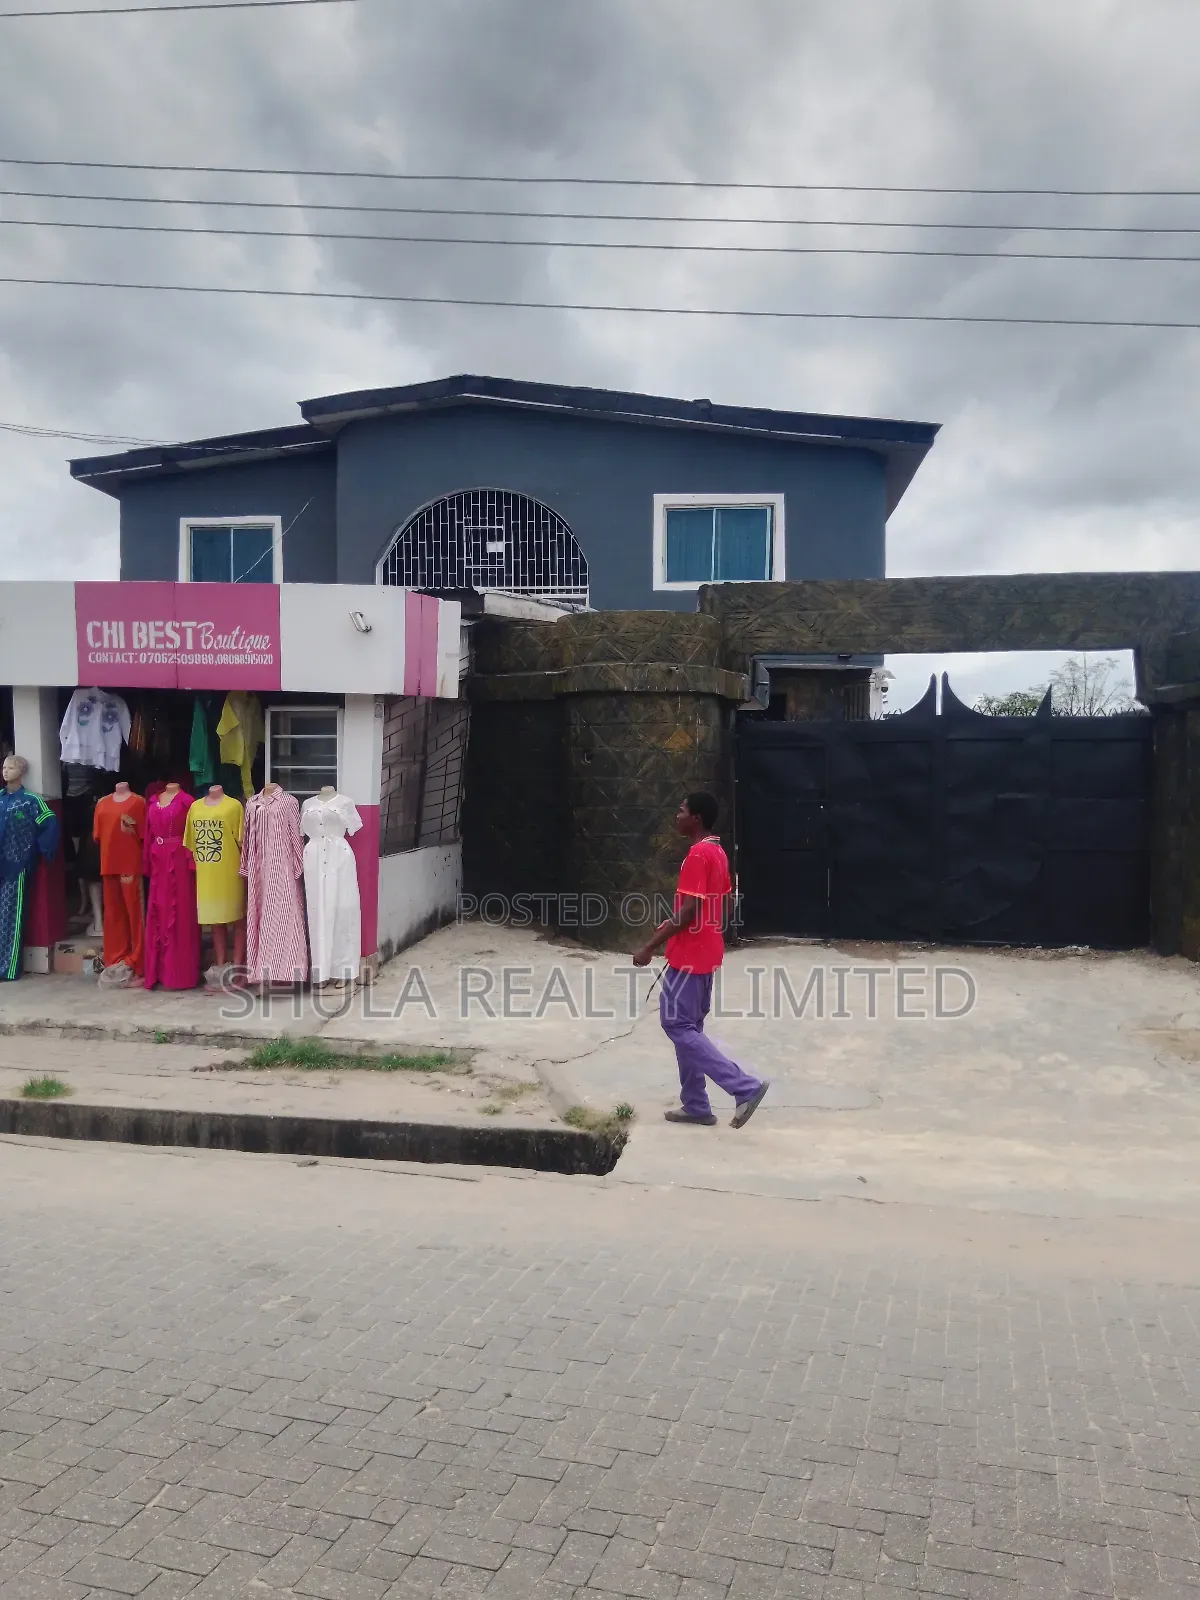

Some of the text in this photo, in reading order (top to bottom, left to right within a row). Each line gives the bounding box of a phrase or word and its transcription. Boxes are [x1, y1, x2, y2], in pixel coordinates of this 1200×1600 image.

[86, 621, 272, 653] CHI BEST Boutique
[88, 652, 138, 664] CONTACT:
